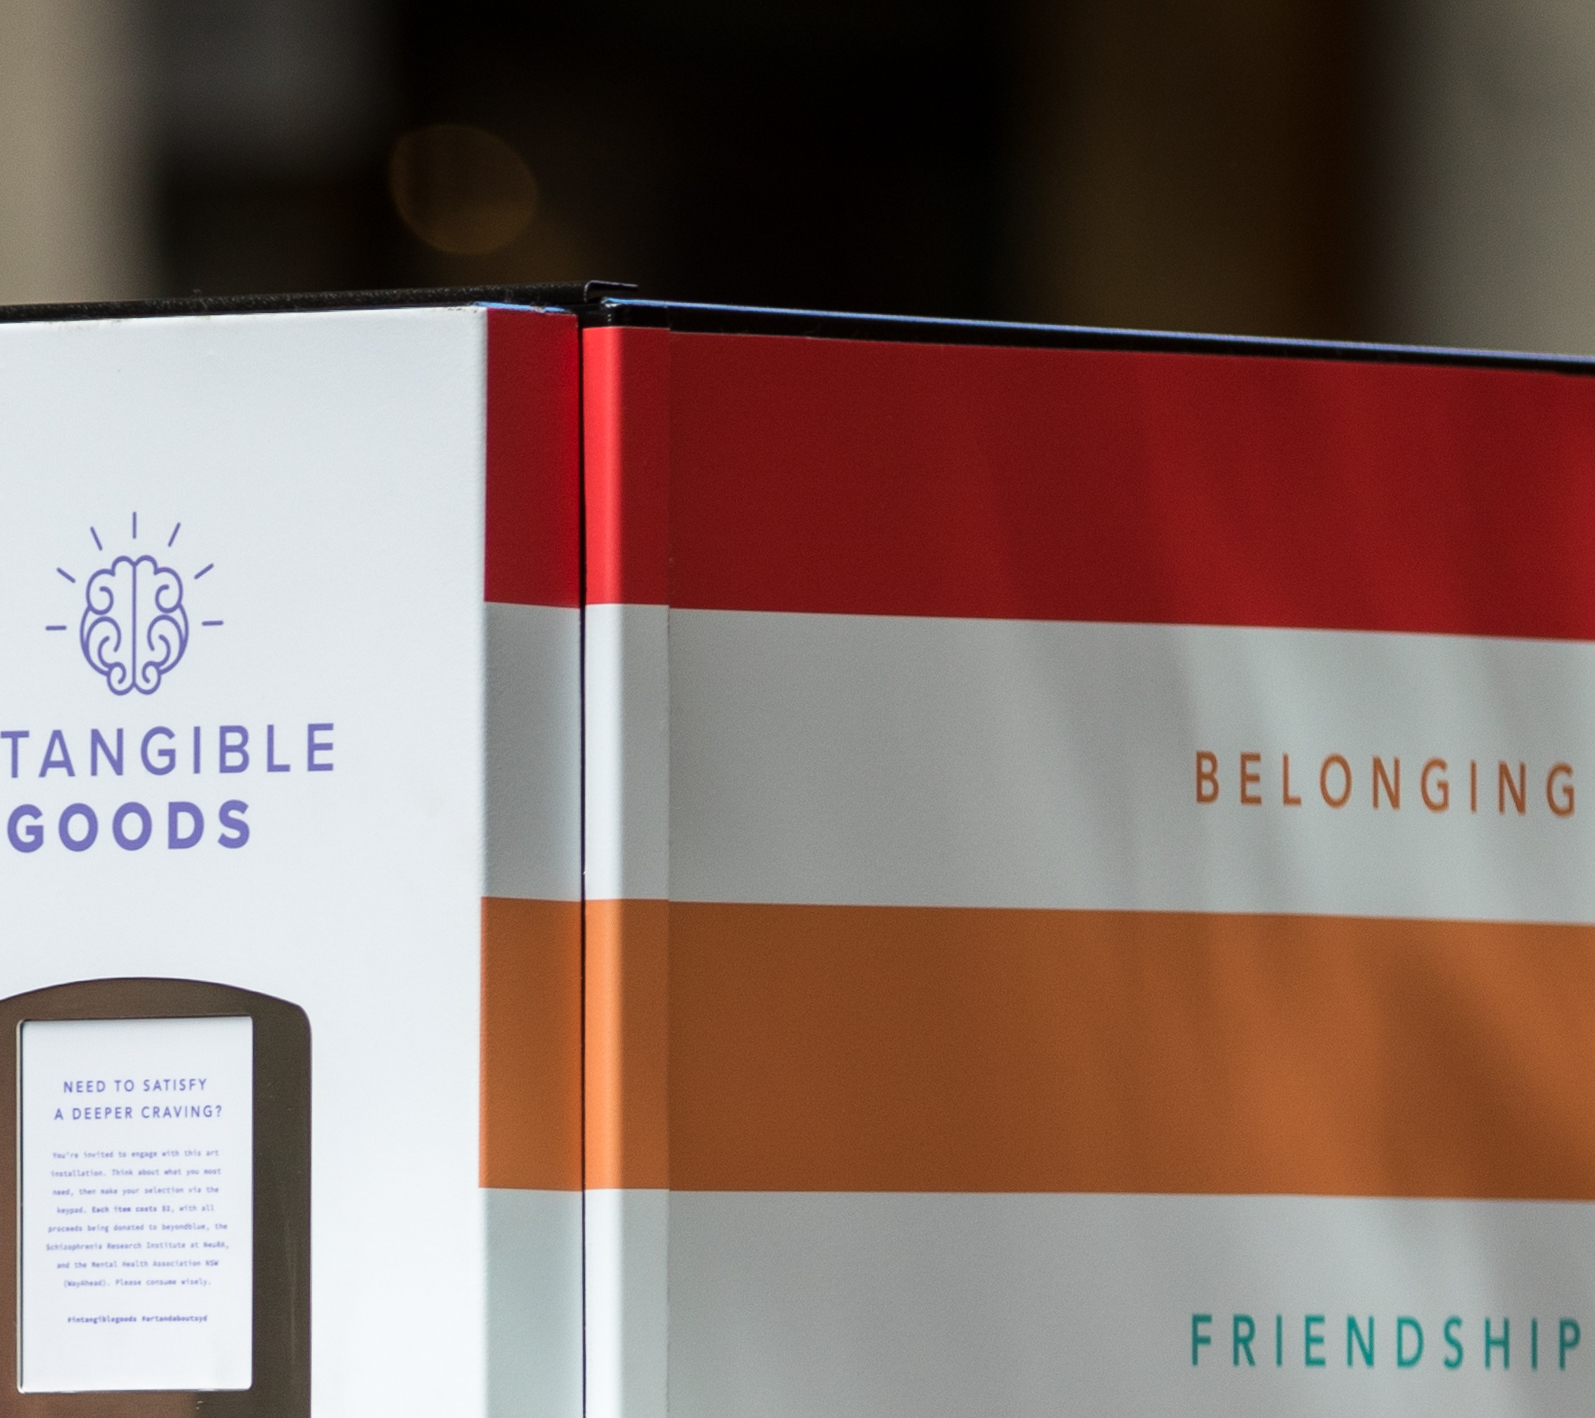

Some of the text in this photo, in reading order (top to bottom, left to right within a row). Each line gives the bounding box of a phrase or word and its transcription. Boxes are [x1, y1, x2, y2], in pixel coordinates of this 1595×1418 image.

[1194, 749, 1577, 818] BELONGING
[6, 799, 251, 854] GOODS
[63, 1078, 207, 1094] NEED TO SATISFY
[53, 1104, 222, 1121] A DEEPER CRAVING?
[83, 1151, 115, 1159] invited
[117, 1150, 128, 1158] to
[130, 1151, 158, 1160] engage
[161, 1150, 180, 1158] with
[183, 1149, 202, 1157] this
[50, 1169, 107, 1177] installation.
[111, 1168, 134, 1177] Think
[137, 1168, 160, 1176] about
[163, 1168, 182, 1176] what
[186, 1169, 200, 1177] you
[78, 1188, 97, 1196] then
[121, 1188, 140, 1196] your
[144, 1186, 185, 1195] selection
[205, 1186, 220, 1194] the
[56, 1207, 87, 1216] keypad.
[91, 1206, 110, 1214] Each
[113, 1205, 132, 1213] item
[201, 1204, 215, 1212] all
[47, 1225, 84, 1233] proceeds
[86, 1224, 110, 1234] being
[112, 1223, 145, 1232] donated
[106, 1242, 143, 1250] Research
[146, 1241, 187, 1249] Institute
[56, 1261, 71, 1269] and
[73, 1261, 88, 1269] the
[90, 1260, 118, 1269] Mental
[114, 1278, 142, 1286] Please
[1190, 1313, 1582, 1372] FRIENDSHIP
